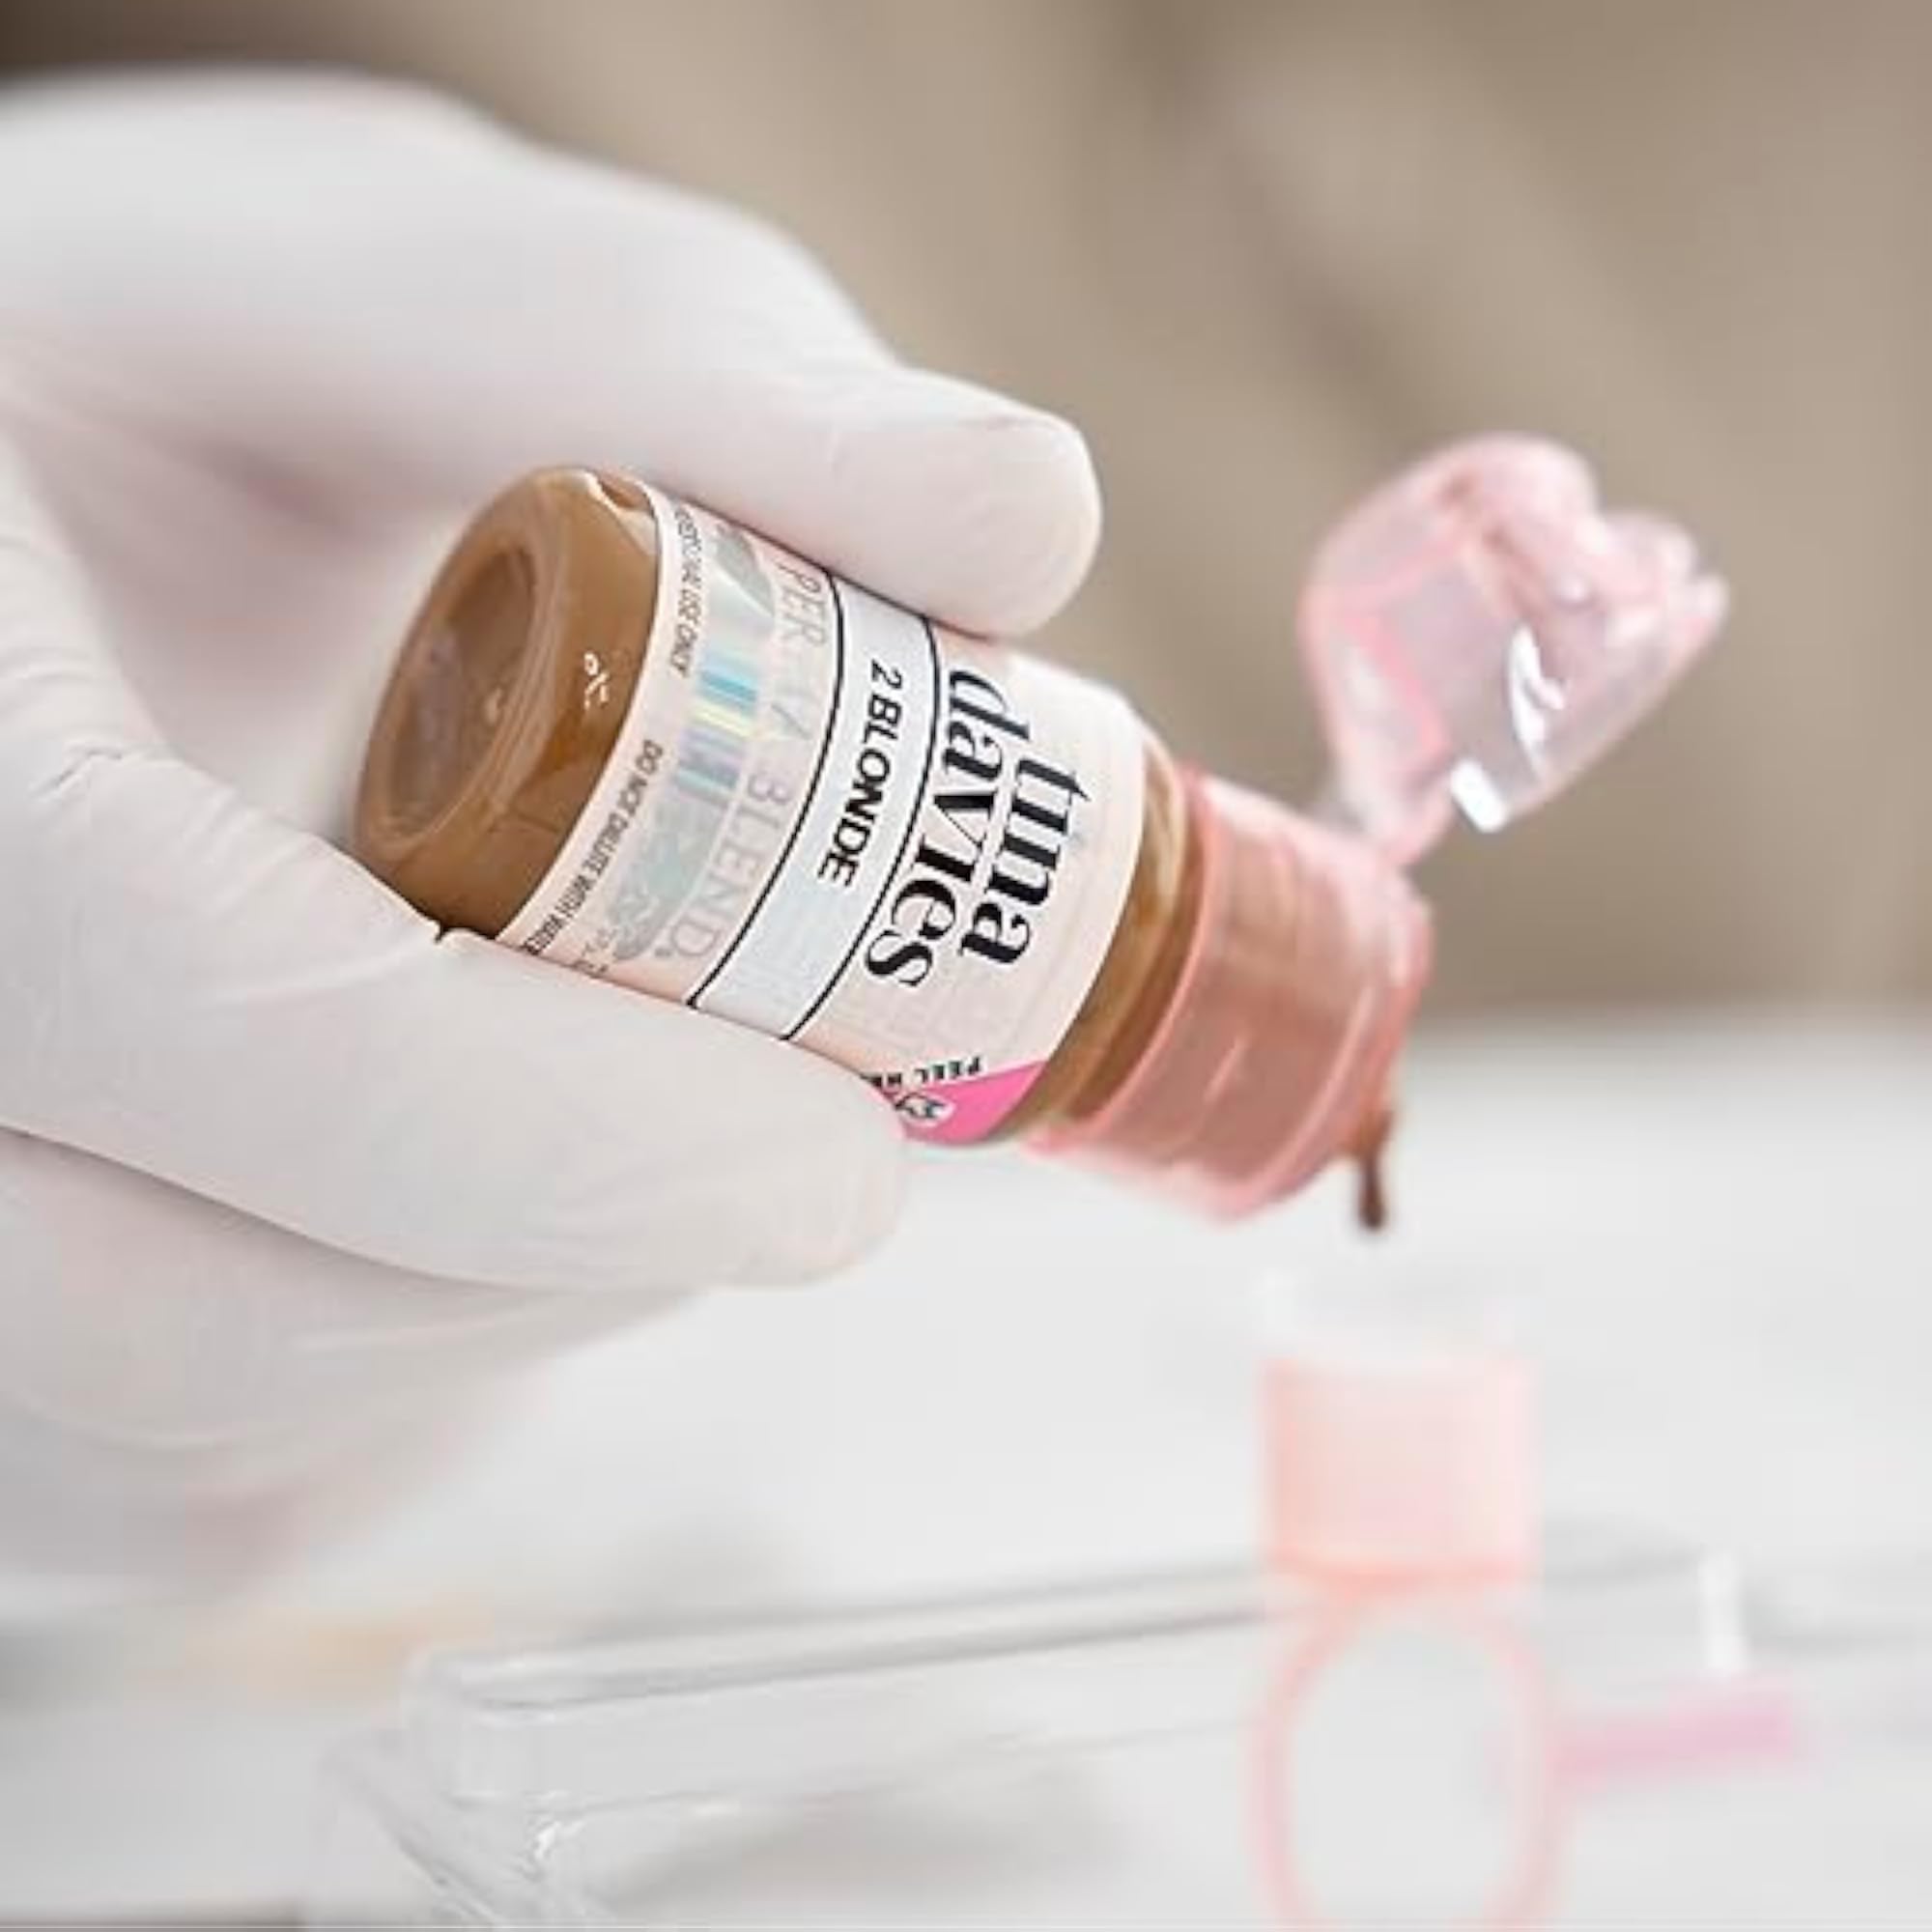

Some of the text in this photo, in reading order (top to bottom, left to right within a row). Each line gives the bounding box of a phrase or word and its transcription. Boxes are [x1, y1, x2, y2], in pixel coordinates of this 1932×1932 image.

[636, 738, 664, 775] DO
[818, 658, 902, 888] 2 BLONDE
[616, 774, 648, 817] NOT
[865, 670, 1030, 986] davies
[958, 757, 1090, 964] tina
[554, 873, 593, 920] WITH
[913, 1055, 981, 1084] PEEL
